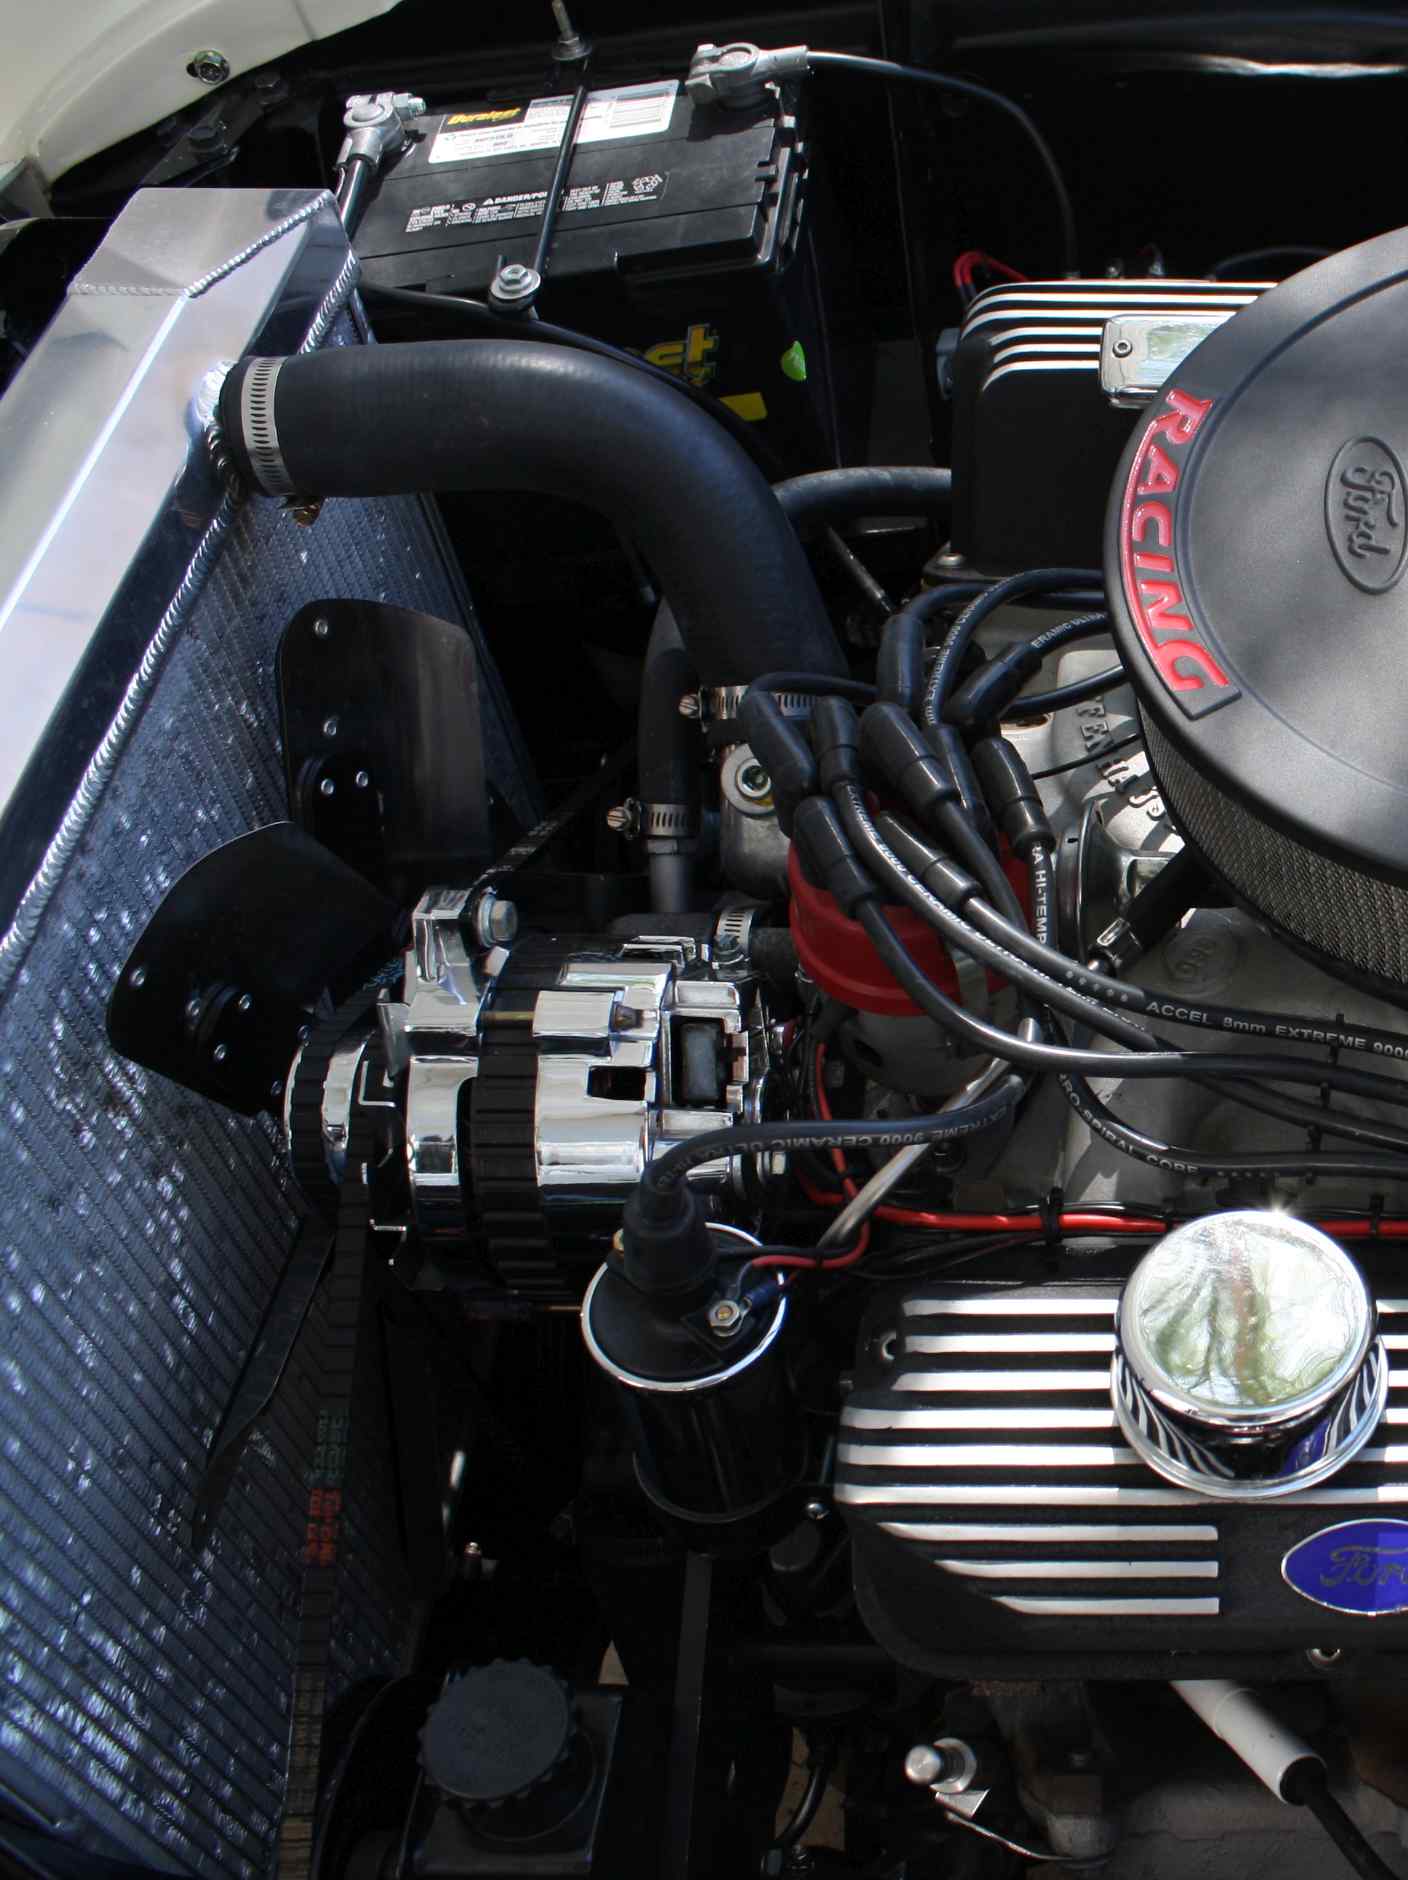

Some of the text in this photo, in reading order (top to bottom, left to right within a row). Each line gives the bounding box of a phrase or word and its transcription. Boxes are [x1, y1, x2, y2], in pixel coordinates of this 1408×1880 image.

[1122, 388, 1230, 692] RACING
[1341, 465, 1398, 560] Ford
[1146, 1001, 1212, 1026] ACCEL
[1274, 1024, 1367, 1050] EXTREME
[771, 1134, 873, 1151] CERAMIC
